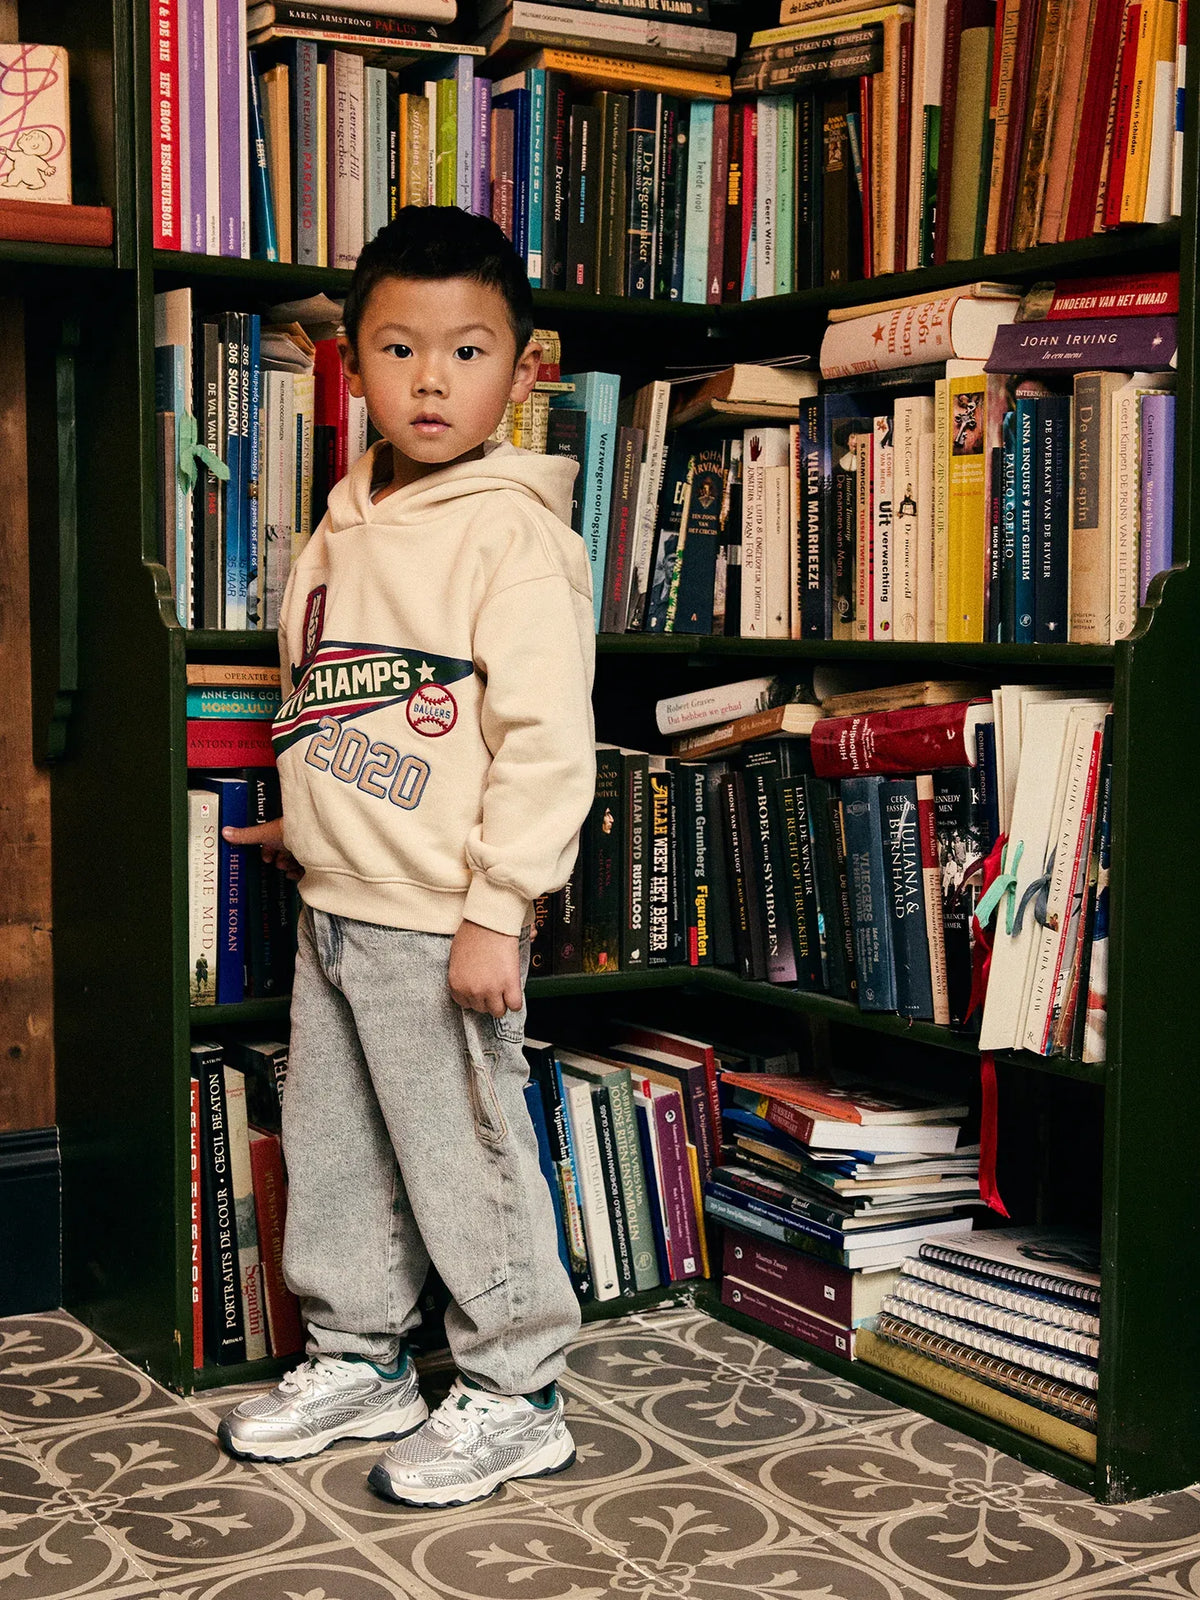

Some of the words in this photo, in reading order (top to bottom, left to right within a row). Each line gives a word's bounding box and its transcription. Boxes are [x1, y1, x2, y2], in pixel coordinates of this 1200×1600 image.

[159, 7, 171, 16] &
[159, 20, 171, 37] DE
[289, 9, 318, 21] KAREN
[321, 14, 372, 28] ARMSTRONG
[375, 22, 417, 36] PAULUS
[159, 40, 171, 61] BIE
[794, 39, 820, 52] STAKEN
[822, 37, 831, 48] EN
[833, 30, 875, 46] STEMPELEN
[789, 62, 817, 75] STAKEN
[818, 60, 827, 71] EN
[828, 54, 872, 69] STEMPELEN
[160, 72, 171, 97] HET
[338, 90, 346, 115] Het
[1134, 80, 1144, 110] Roovers
[160, 100, 172, 141] GROOT
[554, 89, 568, 117] Anna
[1134, 111, 1140, 119] in
[350, 92, 359, 151] Lawrence
[552, 119, 566, 160] Enquist
[1130, 121, 1140, 156] Schiedam
[337, 118, 347, 178] negerboek
[532, 84, 543, 204] NIETZSCHE
[350, 154, 360, 181] Hill
[555, 165, 564, 180] De
[643, 151, 654, 174] De
[695, 160, 707, 189] Tweede
[160, 143, 173, 237] BESCHEURBOEK
[554, 181, 564, 221] verdovers
[695, 193, 704, 213] viool
[638, 176, 653, 262] Regenmaker
[1054, 296, 1096, 311] KINDEREN
[1098, 295, 1115, 308] VAN
[1117, 293, 1134, 306] HET
[1136, 291, 1168, 305] KWAAD
[918, 301, 935, 345] 1969
[1020, 334, 1059, 348] JOHN
[1065, 332, 1118, 346] IRVING
[228, 342, 239, 364] 306
[228, 368, 239, 437] SQUADRON
[1079, 406, 1093, 432] De
[1119, 398, 1130, 431] Geert
[904, 408, 913, 436] Frank
[1021, 412, 1031, 445] ANNA
[1044, 420, 1052, 434] DE
[252, 420, 260, 475] Fotoverkenning
[594, 433, 609, 492] Verzwegen
[904, 439, 913, 477] McCourt
[1043, 437, 1052, 494] OVERKANT
[1079, 438, 1091, 481] witte
[1118, 433, 1129, 471] Kimpen
[747, 466, 755, 502] JONATHAN
[807, 451, 820, 496] VILLA
[1004, 453, 1015, 497] PAULO
[1021, 447, 1031, 497] ENQUIST
[1119, 474, 1128, 489] DE
[745, 504, 755, 539] SAFRAN
[878, 500, 893, 527] Uit
[1021, 509, 1031, 532] HET
[1043, 499, 1052, 520] VAN
[1077, 487, 1091, 522] spin
[1119, 491, 1128, 520] PRINS
[590, 494, 604, 562] oorlogsjaren
[807, 501, 820, 590] MAARHEEZE
[904, 523, 912, 537] De
[1004, 501, 1014, 558] COELHO
[1043, 524, 1051, 538] DE
[1118, 524, 1127, 547] VAN
[228, 554, 237, 568] 35
[251, 557, 258, 567] 50
[745, 542, 754, 569] FOER
[880, 531, 891, 603] verwachting
[904, 539, 912, 570] nieuwe
[992, 550, 999, 560] DE
[1021, 535, 1031, 581] GEHEIM
[1043, 542, 1051, 579] RIVIER
[228, 568, 237, 597] JAAR
[904, 572, 912, 600] wereld
[1118, 551, 1128, 615] FILETTINO
[304, 659, 411, 704] CHAMPS
[201, 702, 273, 714] HONOLULU
[413, 703, 451, 720] BALLERS
[841, 729, 849, 760] Hitlers
[851, 718, 861, 770] hofhouding
[304, 715, 431, 811] 2020
[256, 780, 267, 816] Arthur
[632, 770, 642, 823] WILLIAM
[695, 773, 705, 812] Arnon
[756, 776, 764, 793] HET
[783, 788, 794, 815] HET
[890, 795, 907, 803] CEES
[651, 778, 668, 836] ALLAH
[757, 795, 770, 842] BOEK
[795, 787, 804, 821] LEON
[938, 803, 953, 812] MEN
[632, 827, 642, 860] BOYD
[693, 816, 706, 878] Grunberg
[786, 817, 799, 860] RECHT
[799, 824, 807, 842] DE
[202, 825, 215, 896] SOMME
[653, 837, 667, 874] WEET
[727, 783, 735, 813] SIMONE
[734, 848, 742, 874] VLUGT
[739, 905, 747, 931] WATER
[792, 862, 801, 881] OP
[801, 843, 813, 895] WINTER
[888, 818, 905, 919] BERNHARD
[902, 821, 918, 896] JULIANA
[229, 854, 239, 904] HEILIGE
[632, 864, 642, 930] RUSTELOOS
[652, 876, 667, 902] HET
[861, 852, 873, 922] VLIEGERS
[562, 881, 575, 924] tweeling
[695, 885, 709, 956] Figuranten
[763, 862, 779, 957] SYMBOLEN
[794, 882, 809, 958] TERUGKEER
[906, 901, 919, 915] &
[202, 906, 214, 950] MUD
[228, 908, 239, 952] KORAN
[651, 906, 667, 951] BETER
[1040, 937, 1053, 972] MARK
[1033, 978, 1045, 1014] SHAW
[208, 1073, 223, 1130] BEATON
[609, 1083, 625, 1128] JOODSE
[553, 1104, 569, 1165] Vrijmetselarij
[616, 1129, 630, 1162] RITEN
[213, 1136, 226, 1173] CECIL
[621, 1163, 632, 1179] EN
[217, 1187, 230, 1228] COUR
[622, 1179, 640, 1241] SYMBOLEN
[191, 1181, 199, 1303] HERZOG
[220, 1230, 231, 1248] DE
[221, 1253, 237, 1329] PORTRAITS
[241, 1264, 265, 1336] Segantini
